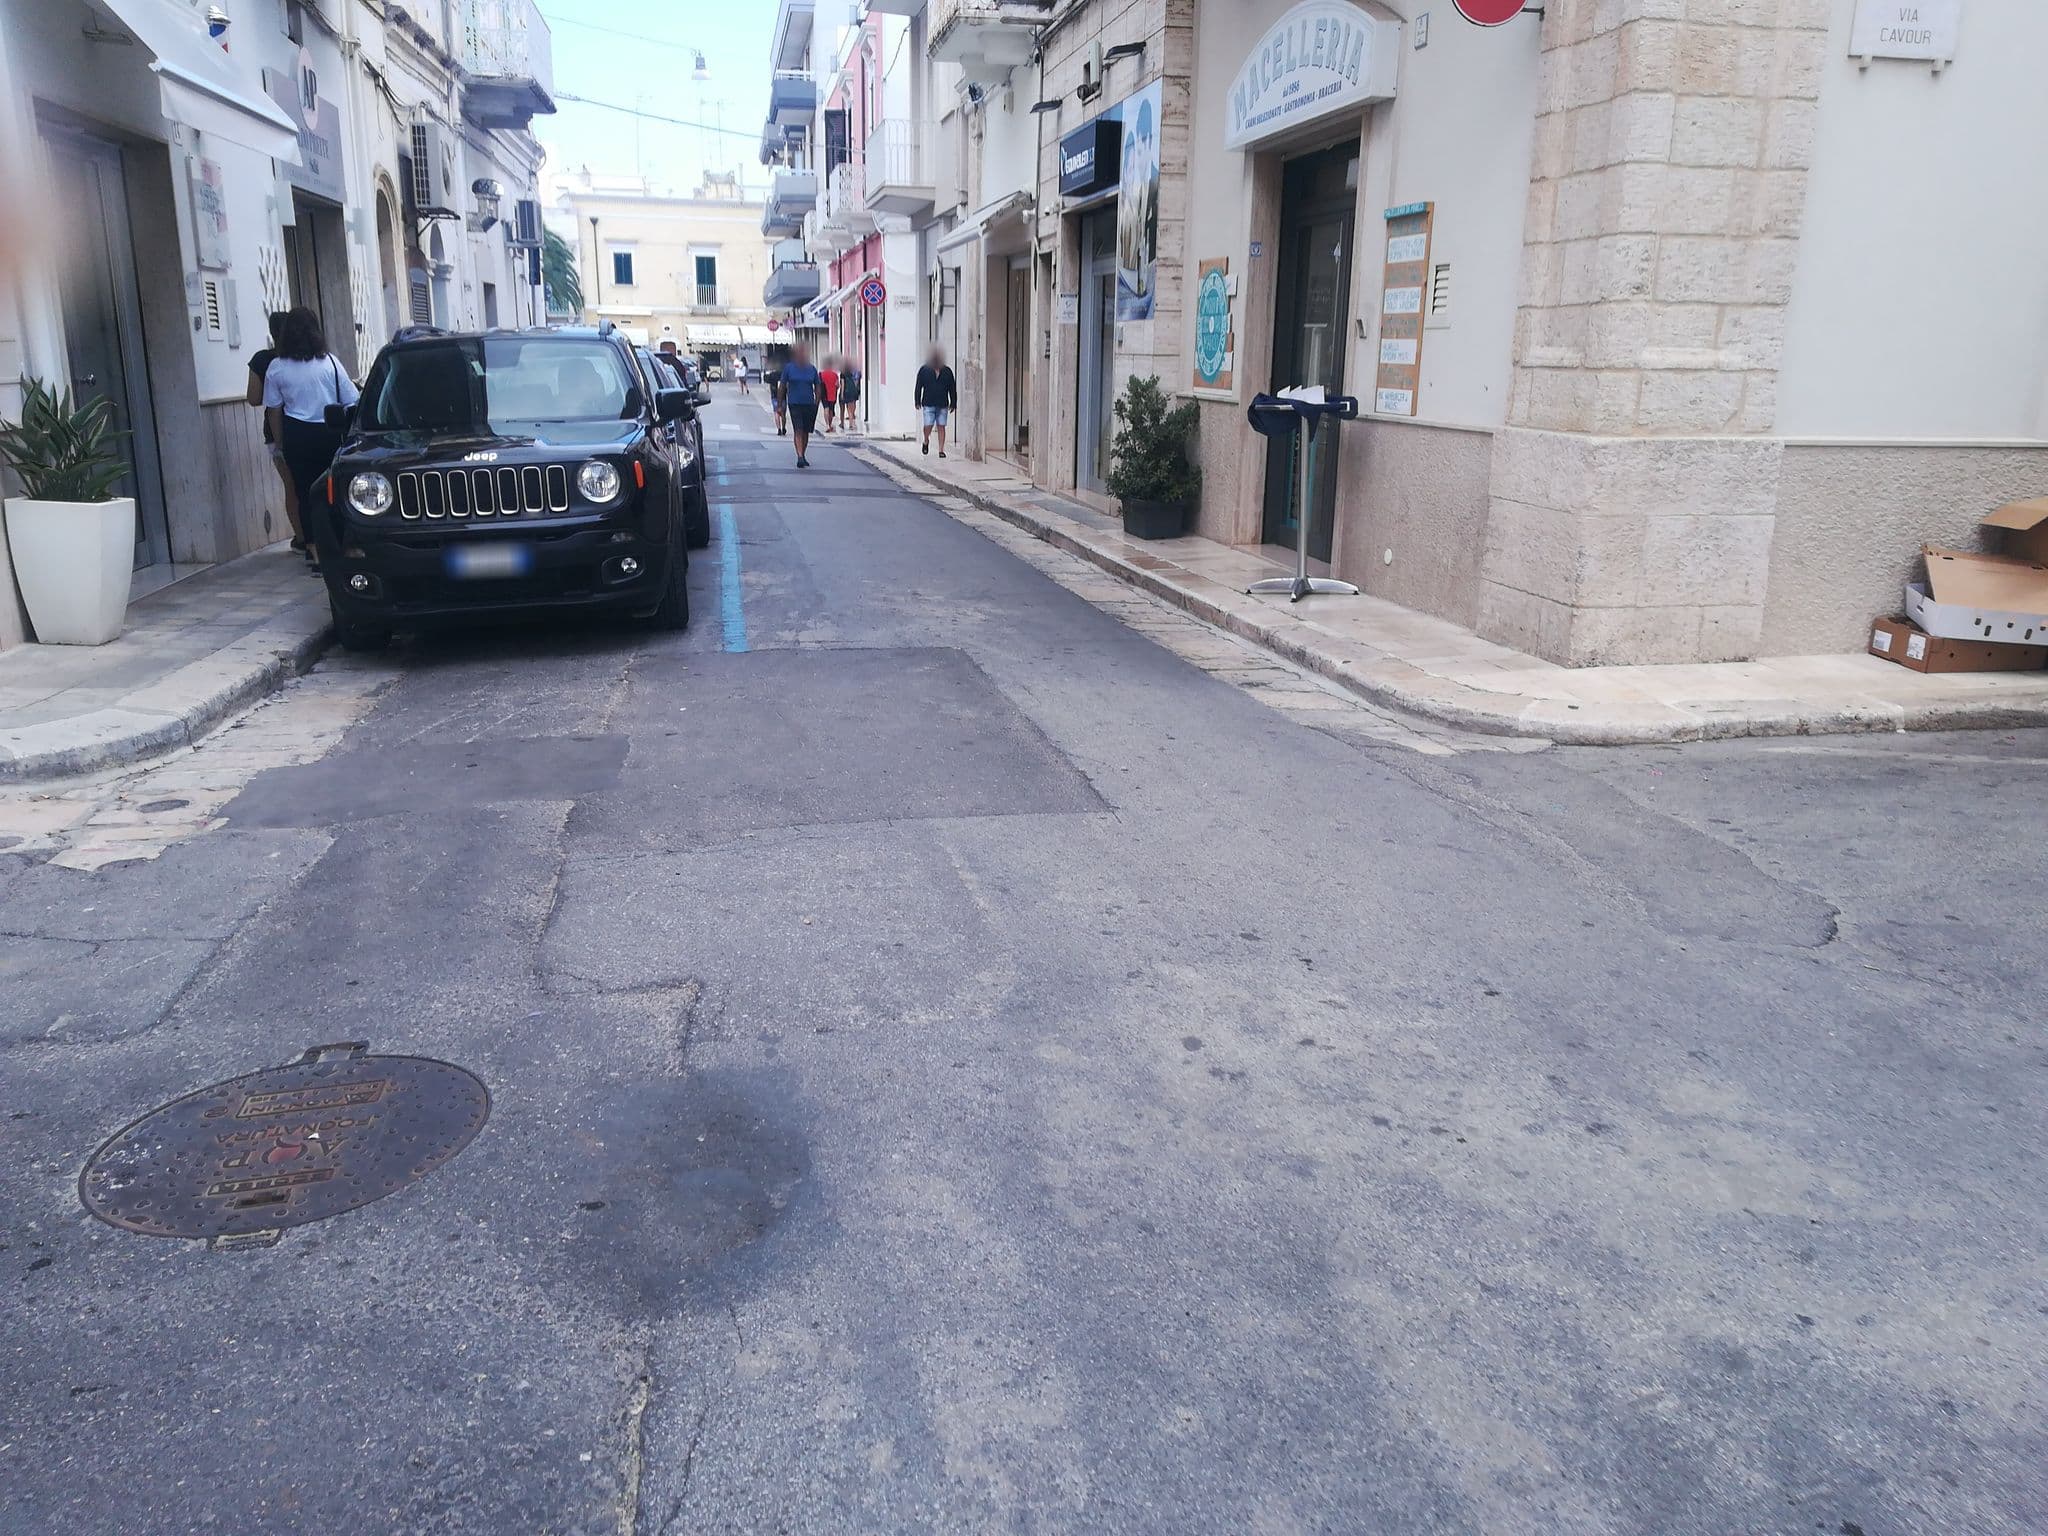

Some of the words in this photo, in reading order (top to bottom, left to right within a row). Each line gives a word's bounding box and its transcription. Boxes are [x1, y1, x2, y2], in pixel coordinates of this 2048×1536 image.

[1899, 7, 1919, 22] VIA
[1880, 27, 1932, 44] CAVOUR
[1233, 17, 1364, 130] MACELLERIA
[1284, 91, 1316, 113] GASTRONOMIA
[1318, 80, 1342, 100] BRACERIA
[464, 452, 498, 462] Jeep
[216, 1117, 376, 1143] FOGNATURA
